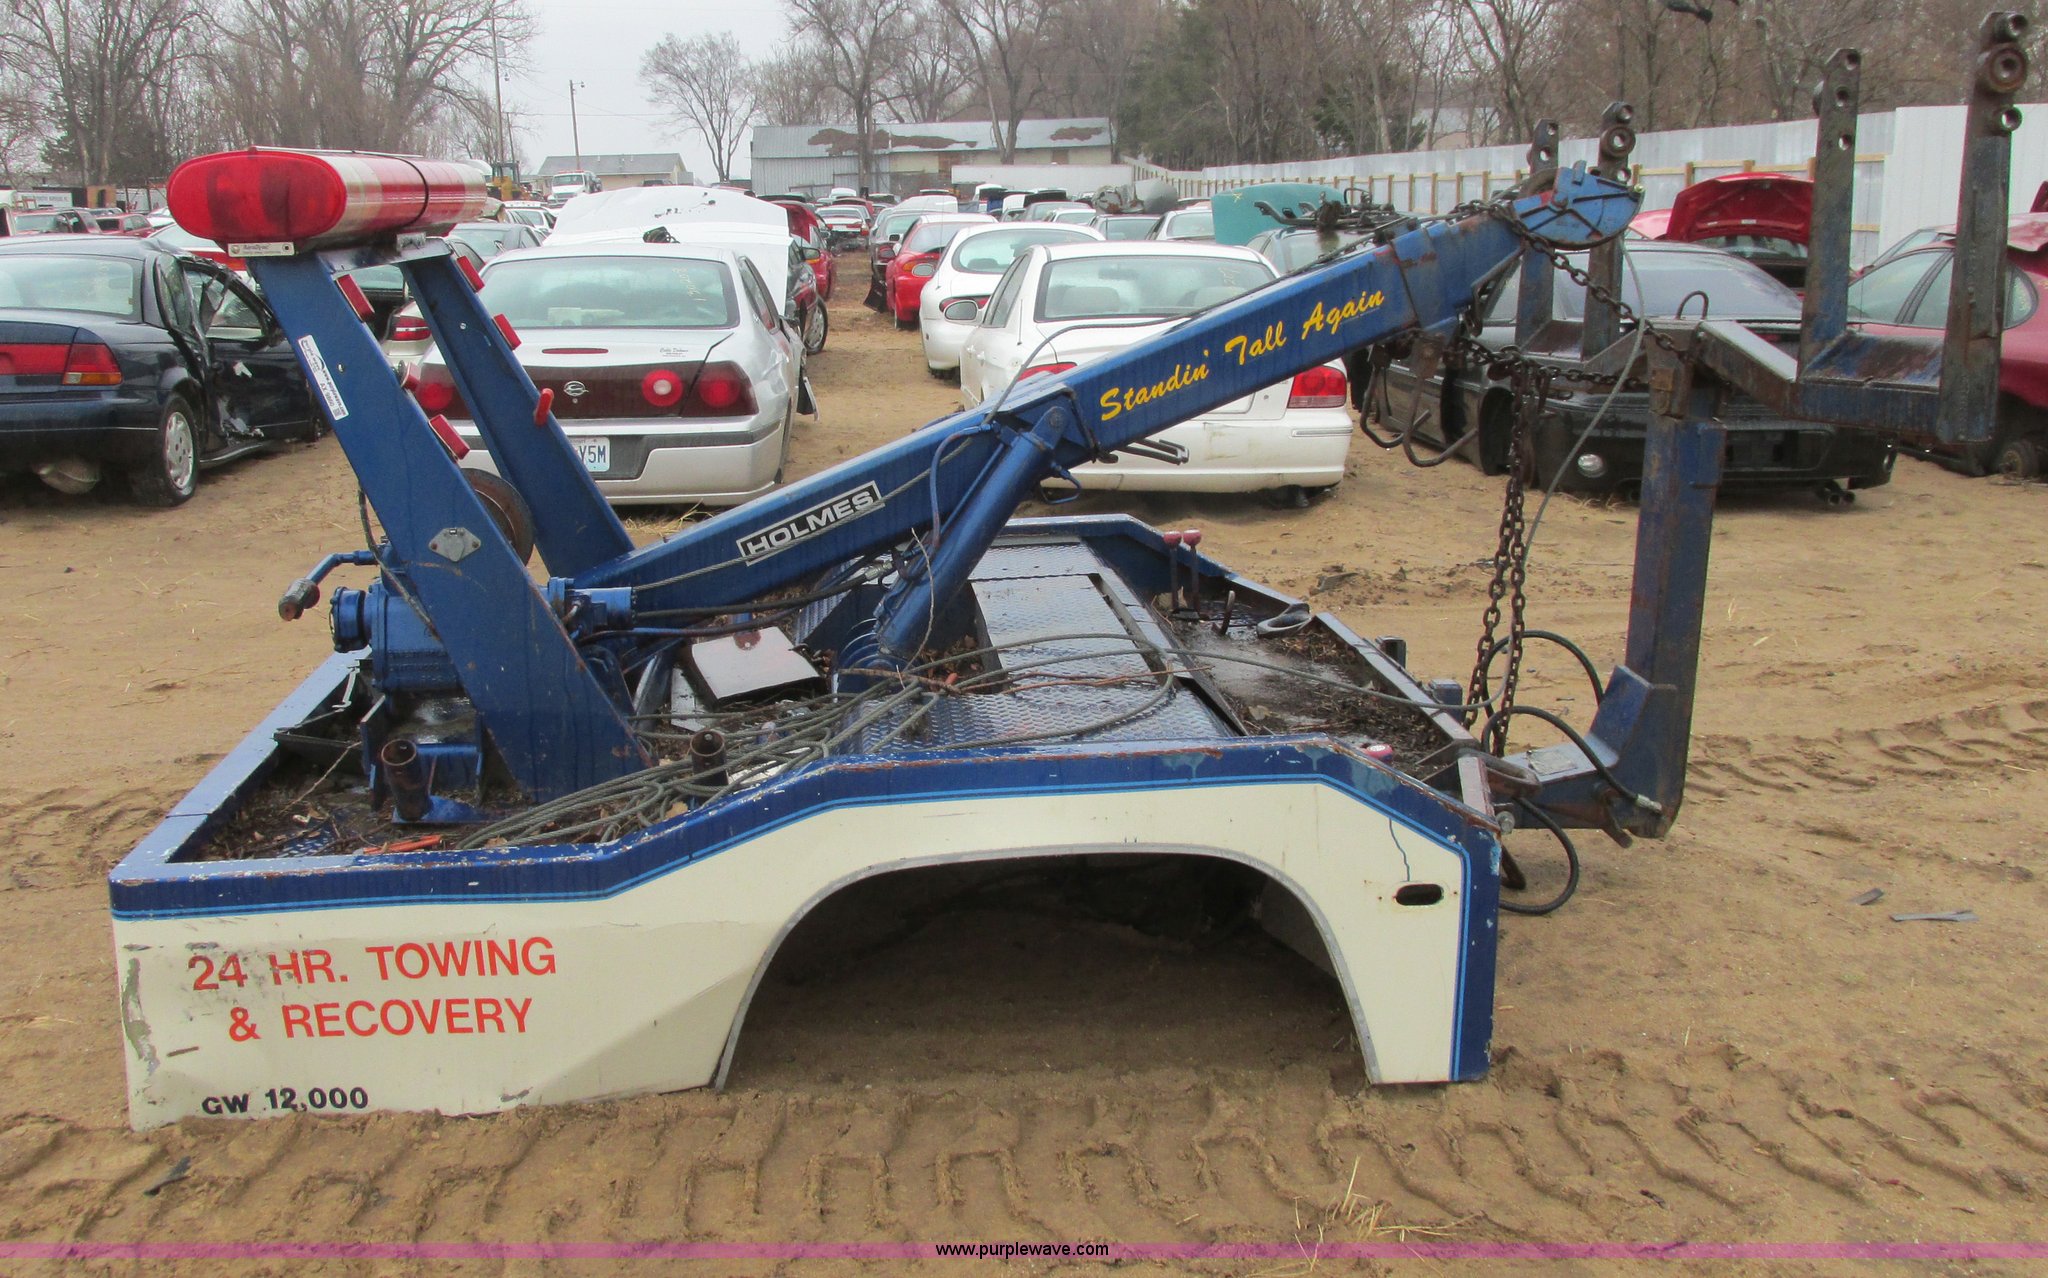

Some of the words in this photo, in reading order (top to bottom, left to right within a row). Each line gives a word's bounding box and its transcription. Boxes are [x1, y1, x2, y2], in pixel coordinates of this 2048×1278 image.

[1100, 349, 1210, 422] Standin'
[1225, 321, 1288, 366] Tall
[1301, 289, 1385, 340] Again
[746, 490, 874, 556] HOLMES
[188, 954, 248, 991] 24
[268, 949, 348, 986] HR.
[365, 936, 557, 982] TOWING
[228, 1006, 262, 1042] &
[281, 998, 533, 1039] RECOVERY
[201, 1093, 249, 1115] GW
[265, 1087, 369, 1112] 12,000
